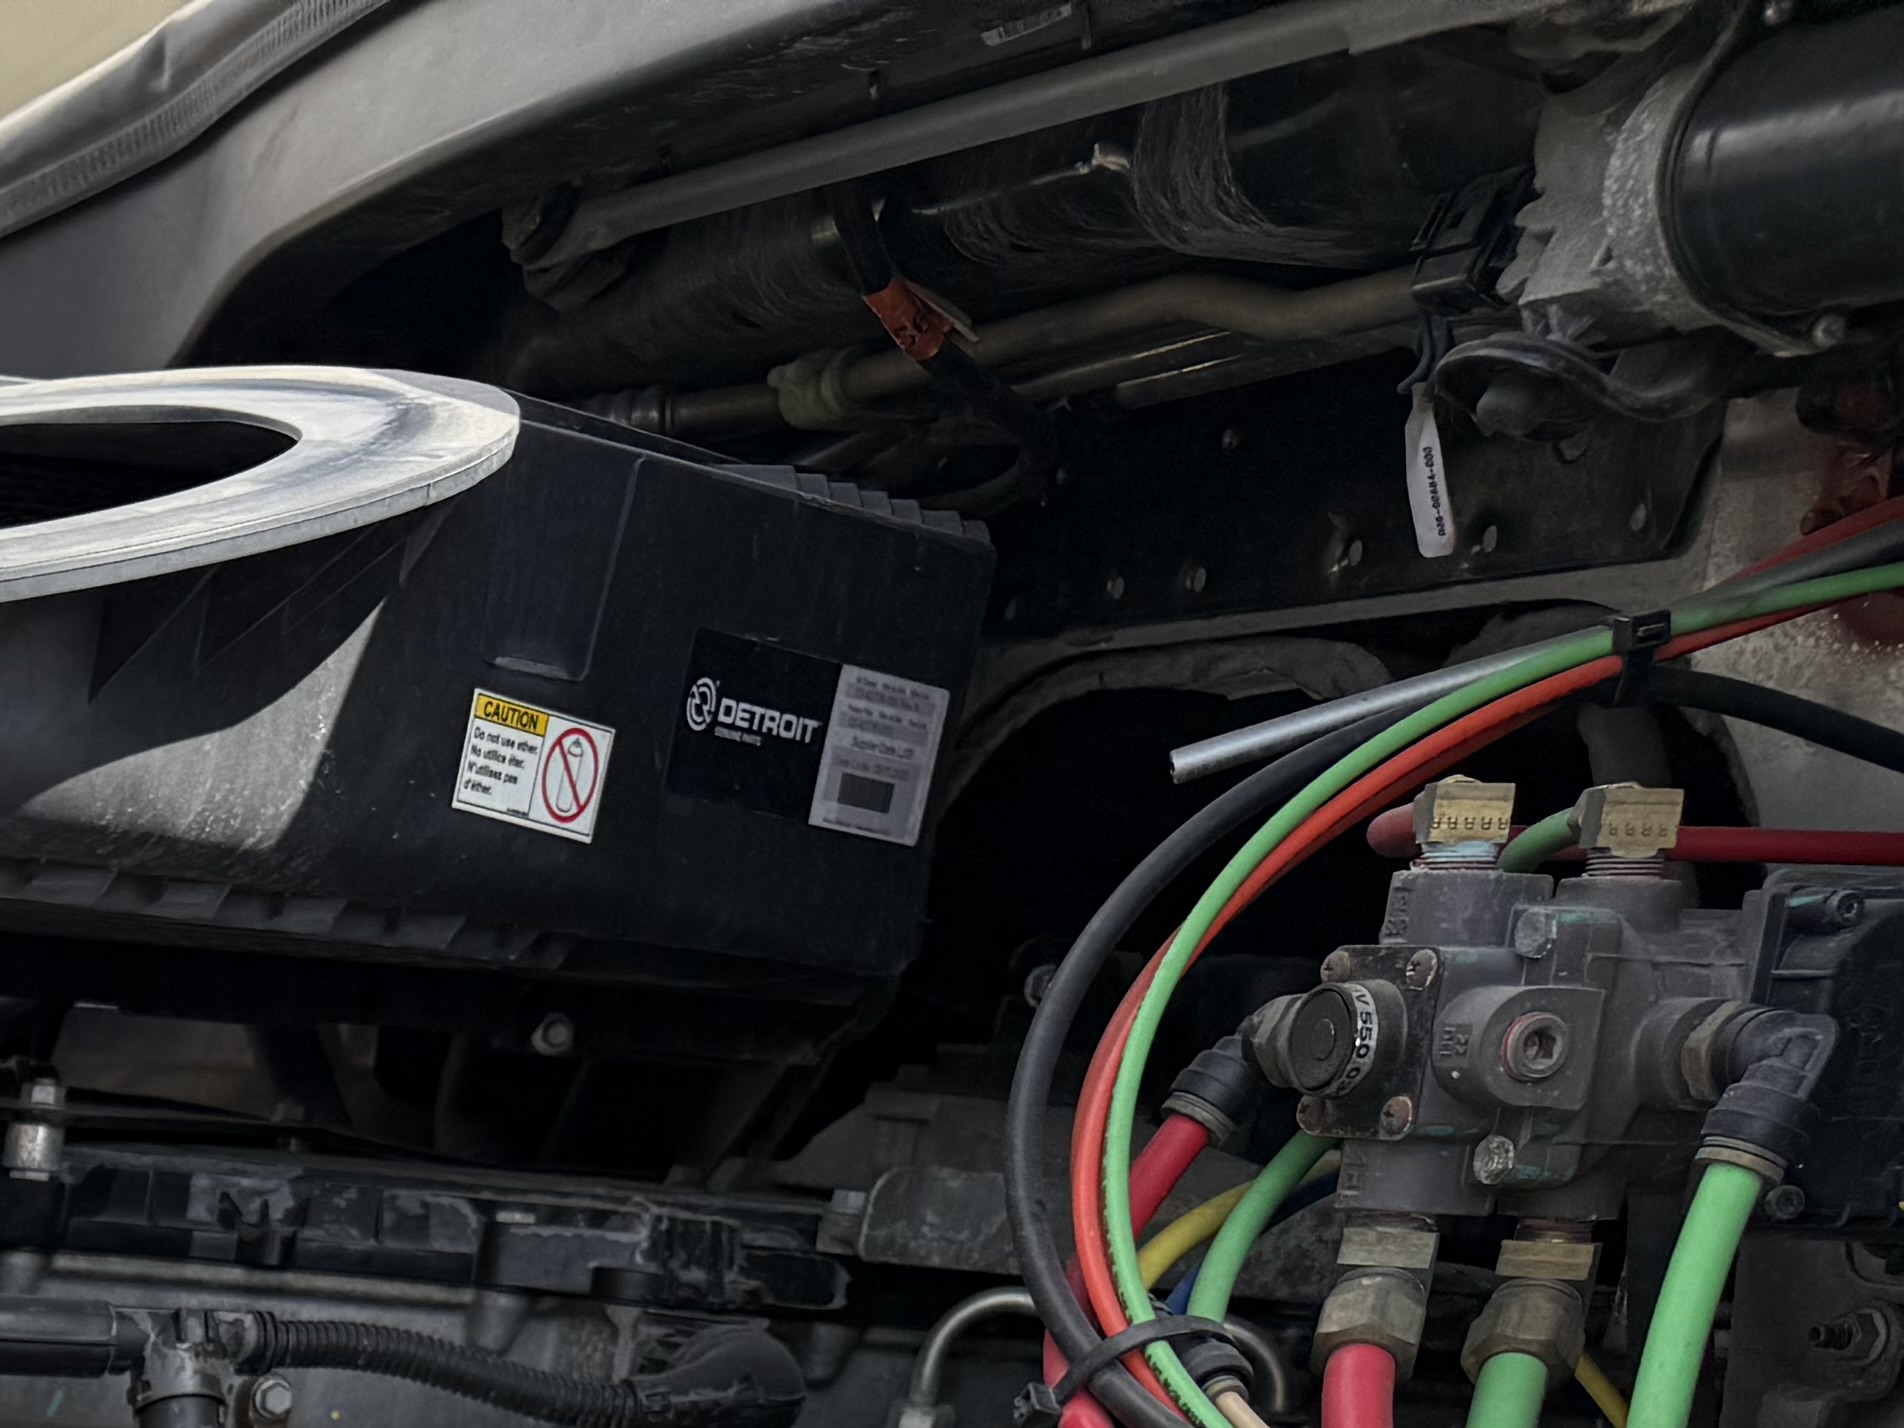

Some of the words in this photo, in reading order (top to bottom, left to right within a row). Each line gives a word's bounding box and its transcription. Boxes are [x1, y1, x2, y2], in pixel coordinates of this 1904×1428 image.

[484, 701, 539, 730] CAUTION
[717, 696, 820, 744] DETROIT
[474, 726, 485, 740] Do
[486, 733, 500, 745] not
[501, 737, 515, 749] use
[1355, 1010, 1374, 1060] 550
